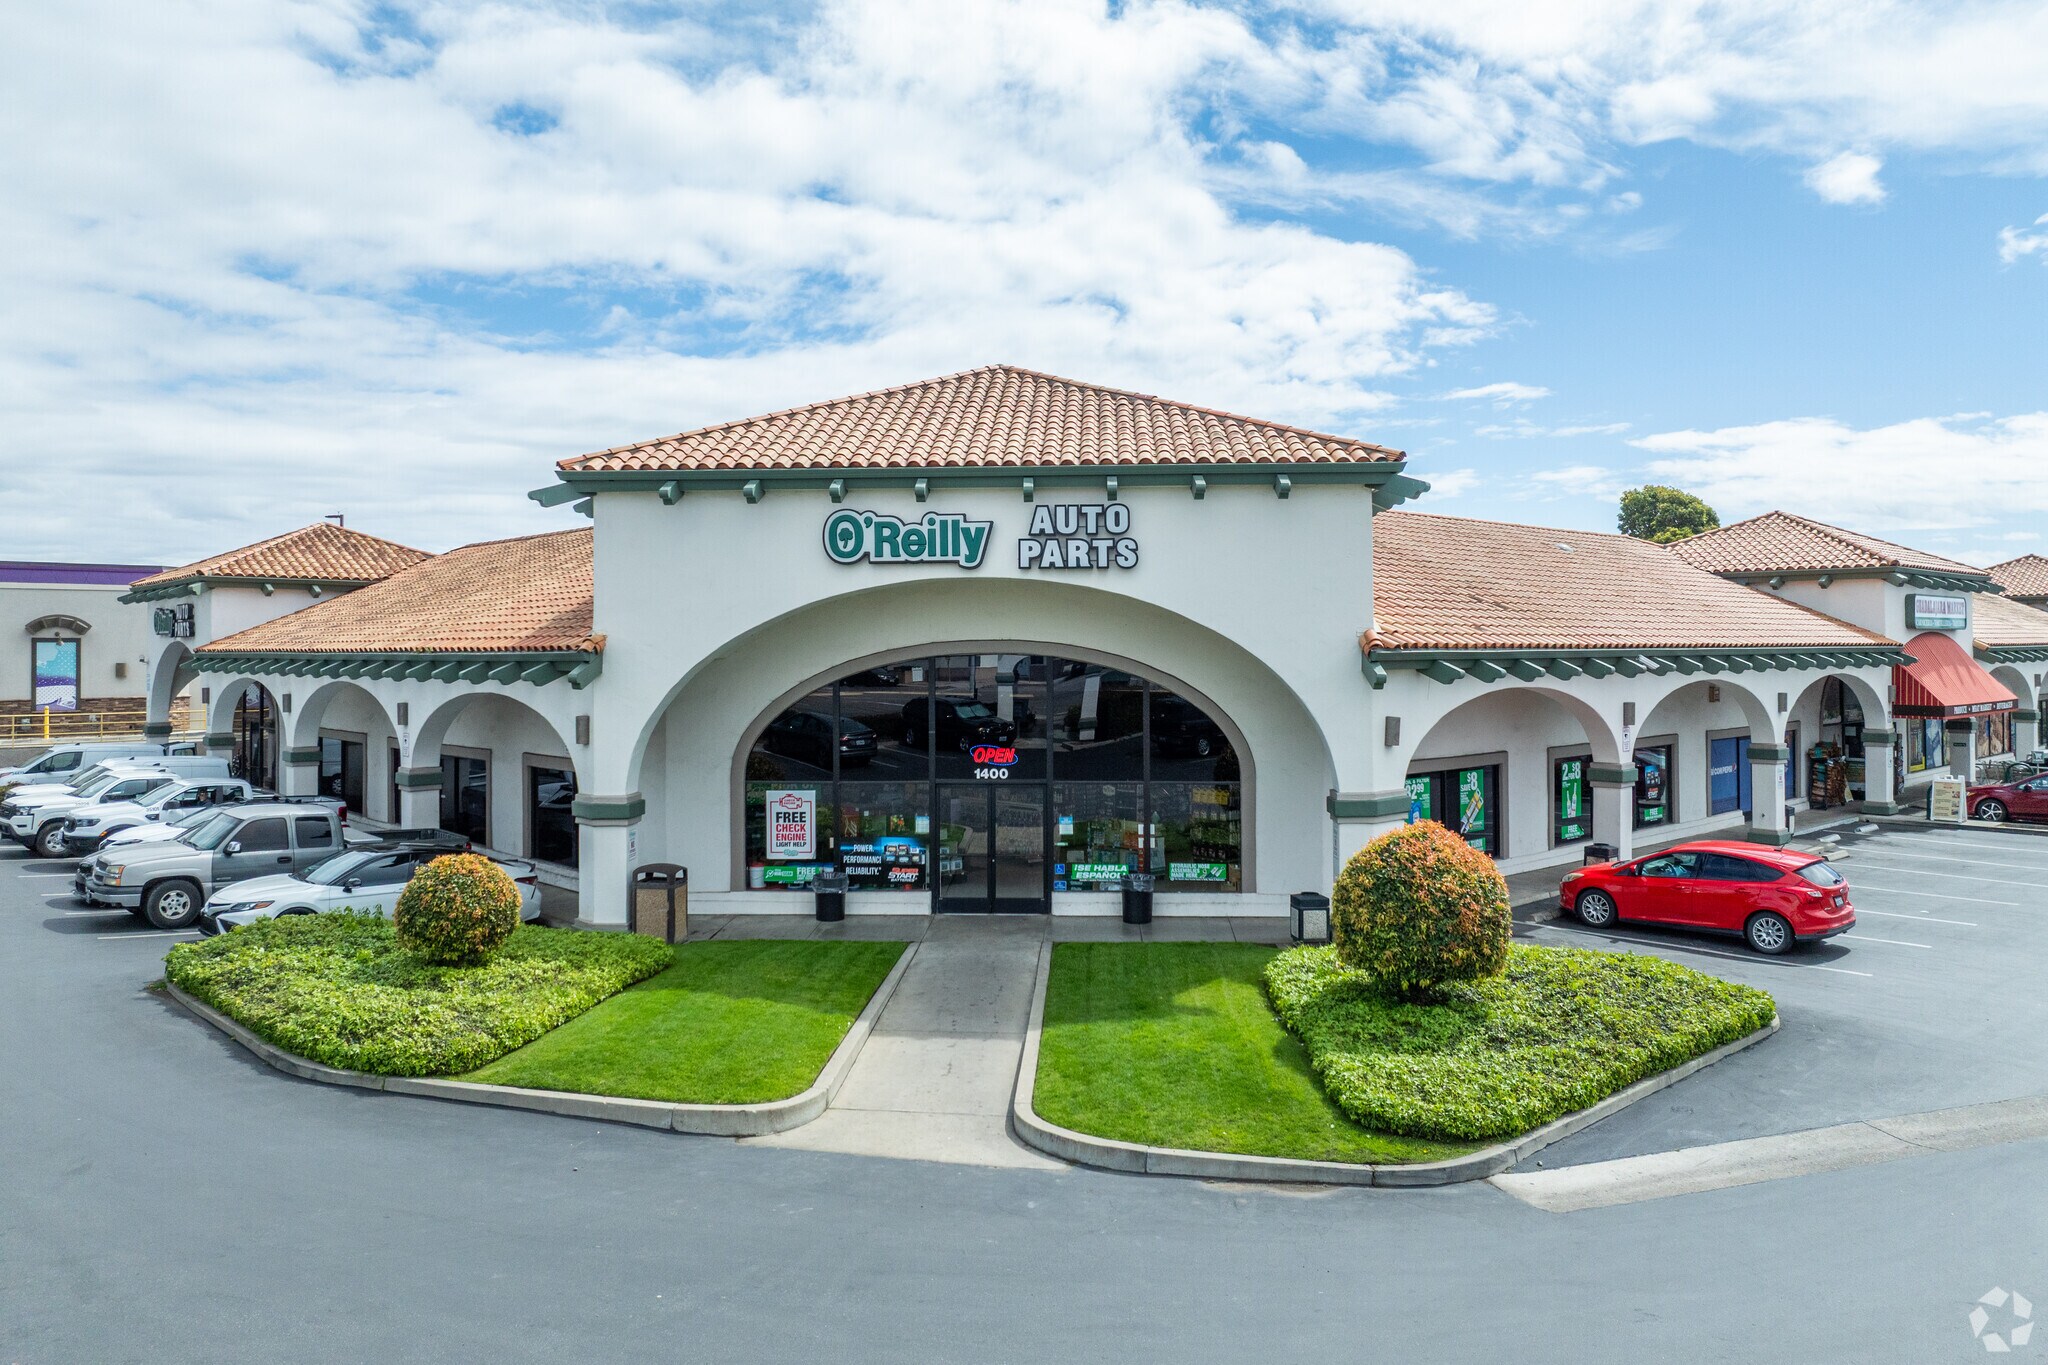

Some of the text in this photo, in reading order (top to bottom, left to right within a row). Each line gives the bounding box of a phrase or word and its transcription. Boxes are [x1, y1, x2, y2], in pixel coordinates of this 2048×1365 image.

[1029, 504, 1130, 536] AUTO
[826, 512, 989, 566] O'Reilly
[1018, 538, 1139, 569] PARTS
[175, 603, 189, 620] AUTO
[174, 620, 190, 637] PARTS
[973, 747, 1015, 763] OPEN
[974, 768, 1009, 779] 1400
[1562, 763, 1569, 780] 2
[1571, 762, 1581, 778] $8
[1466, 771, 1478, 791] $8
[776, 812, 807, 823] FREE
[776, 824, 806, 833] CHECK
[1568, 824, 1577, 833] FREE
[776, 833, 807, 841] ENGINE
[796, 866, 816, 875] FREE
